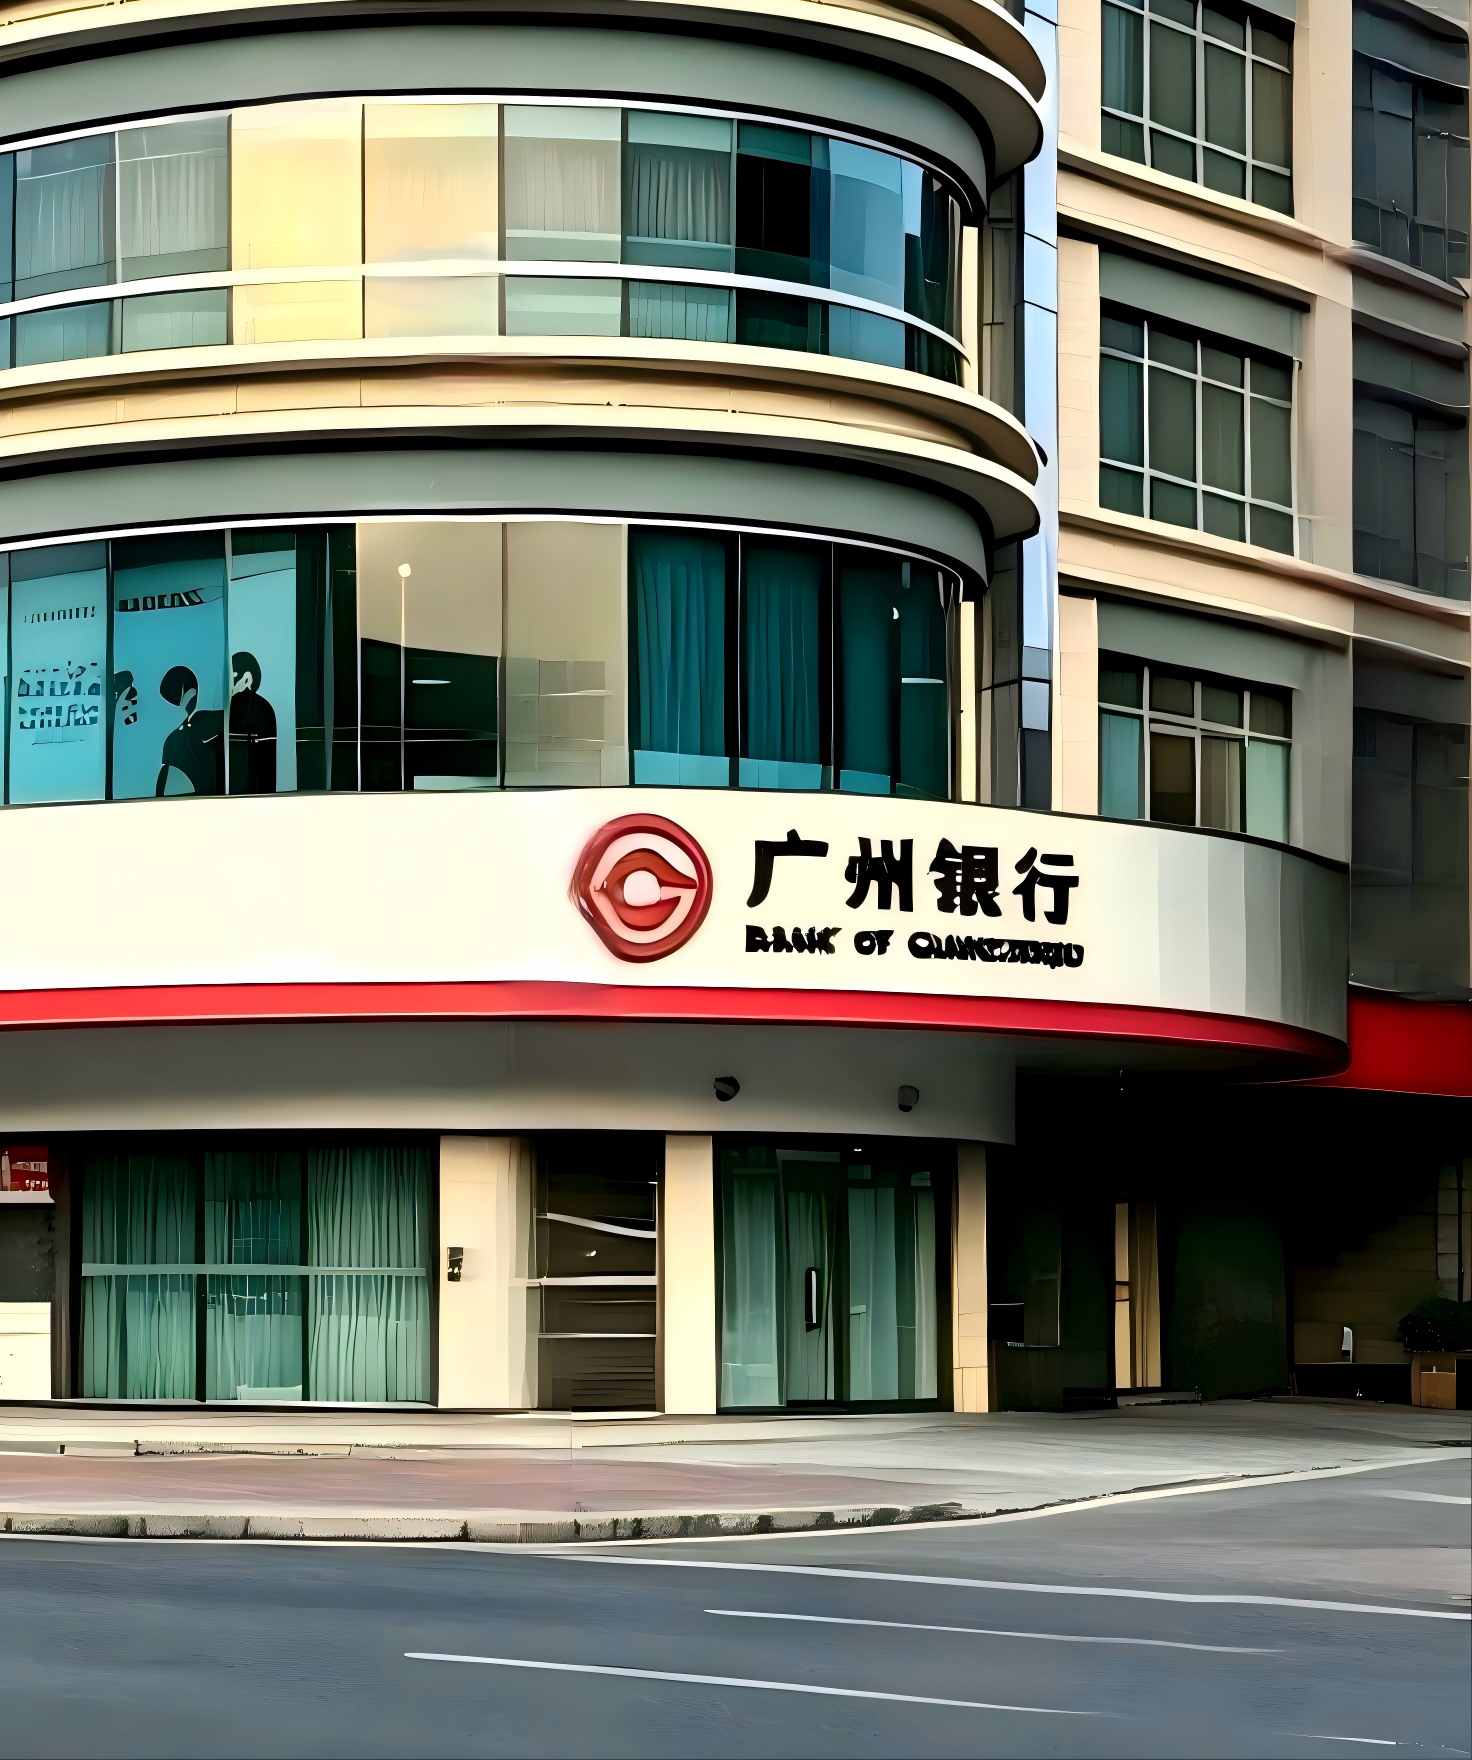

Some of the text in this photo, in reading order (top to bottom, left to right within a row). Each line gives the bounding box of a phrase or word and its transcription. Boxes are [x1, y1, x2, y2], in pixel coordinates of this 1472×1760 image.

[746, 827, 1080, 925] 广州银行
[853, 929, 895, 956] OF
